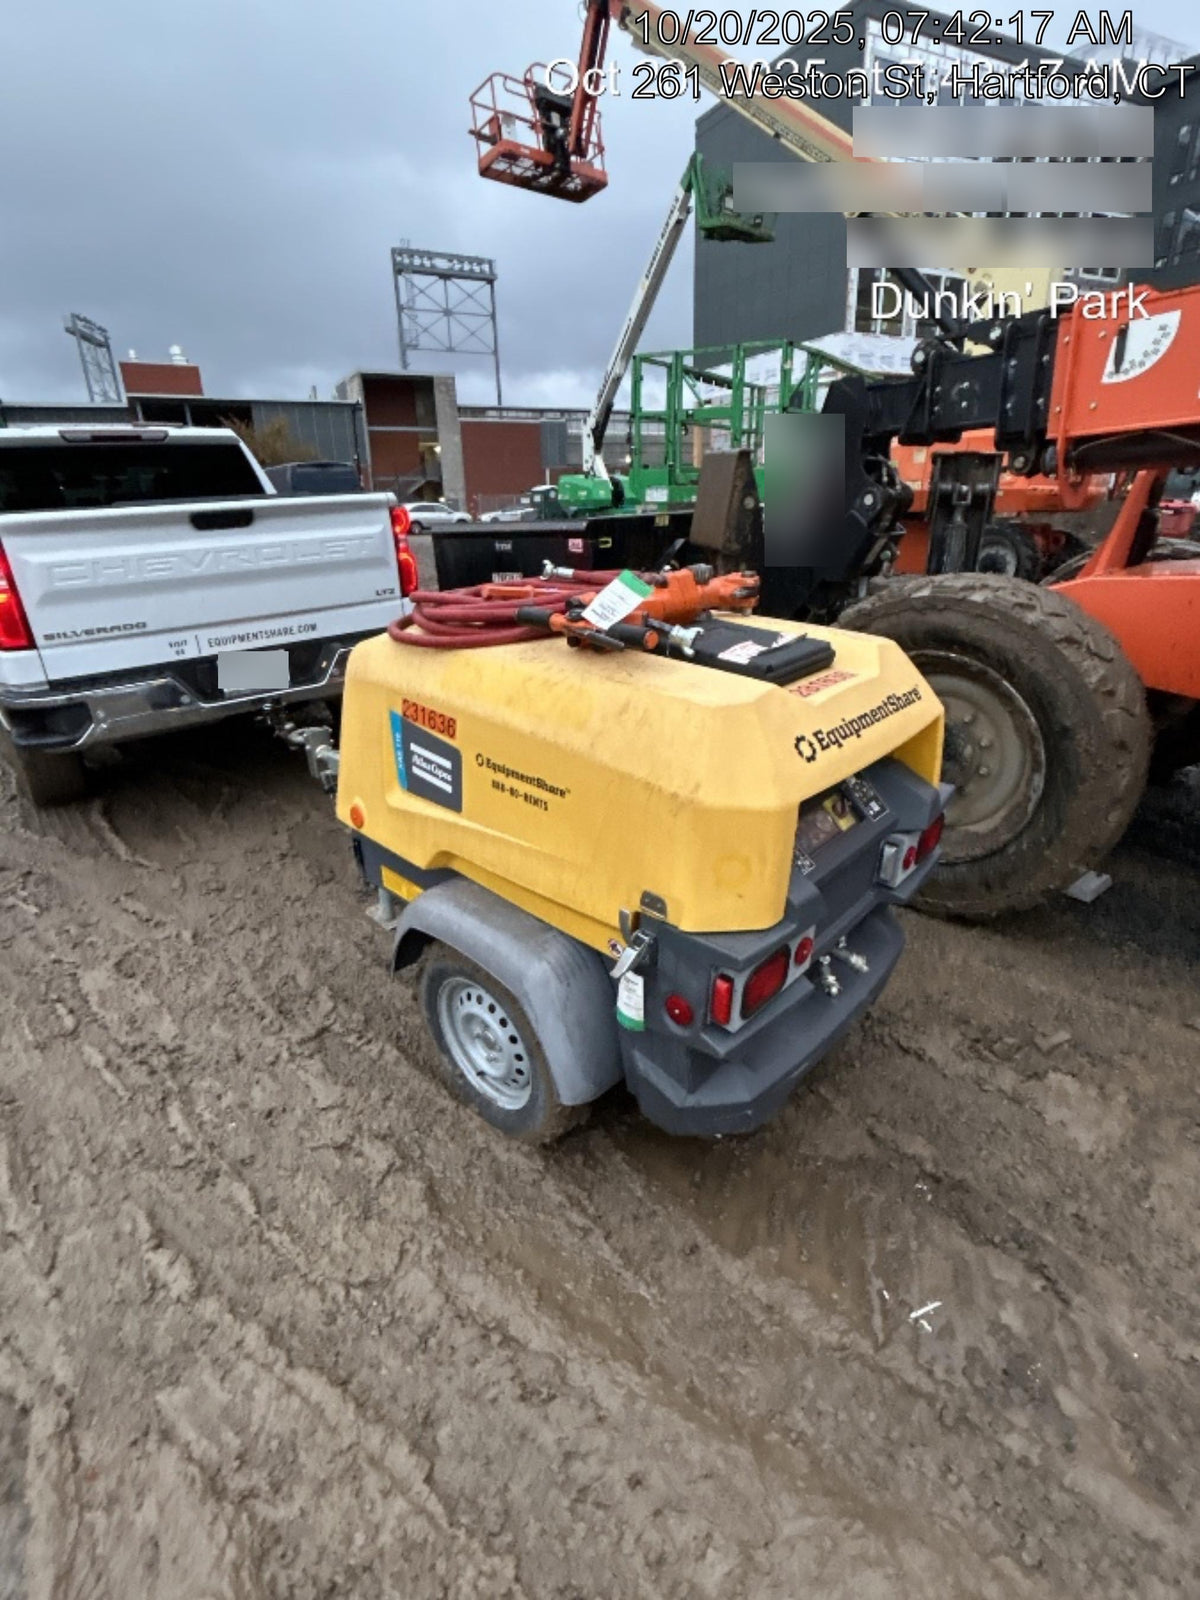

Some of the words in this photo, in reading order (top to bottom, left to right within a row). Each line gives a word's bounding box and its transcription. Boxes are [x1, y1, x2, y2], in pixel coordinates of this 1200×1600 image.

[50, 537, 378, 586] CHEVROLET
[42, 621, 148, 641] SILVERADO
[207, 623, 318, 648] EQUIPMENTSHARE.COM
[402, 698, 457, 738] 231636
[811, 686, 922, 751] EquipmentShare
